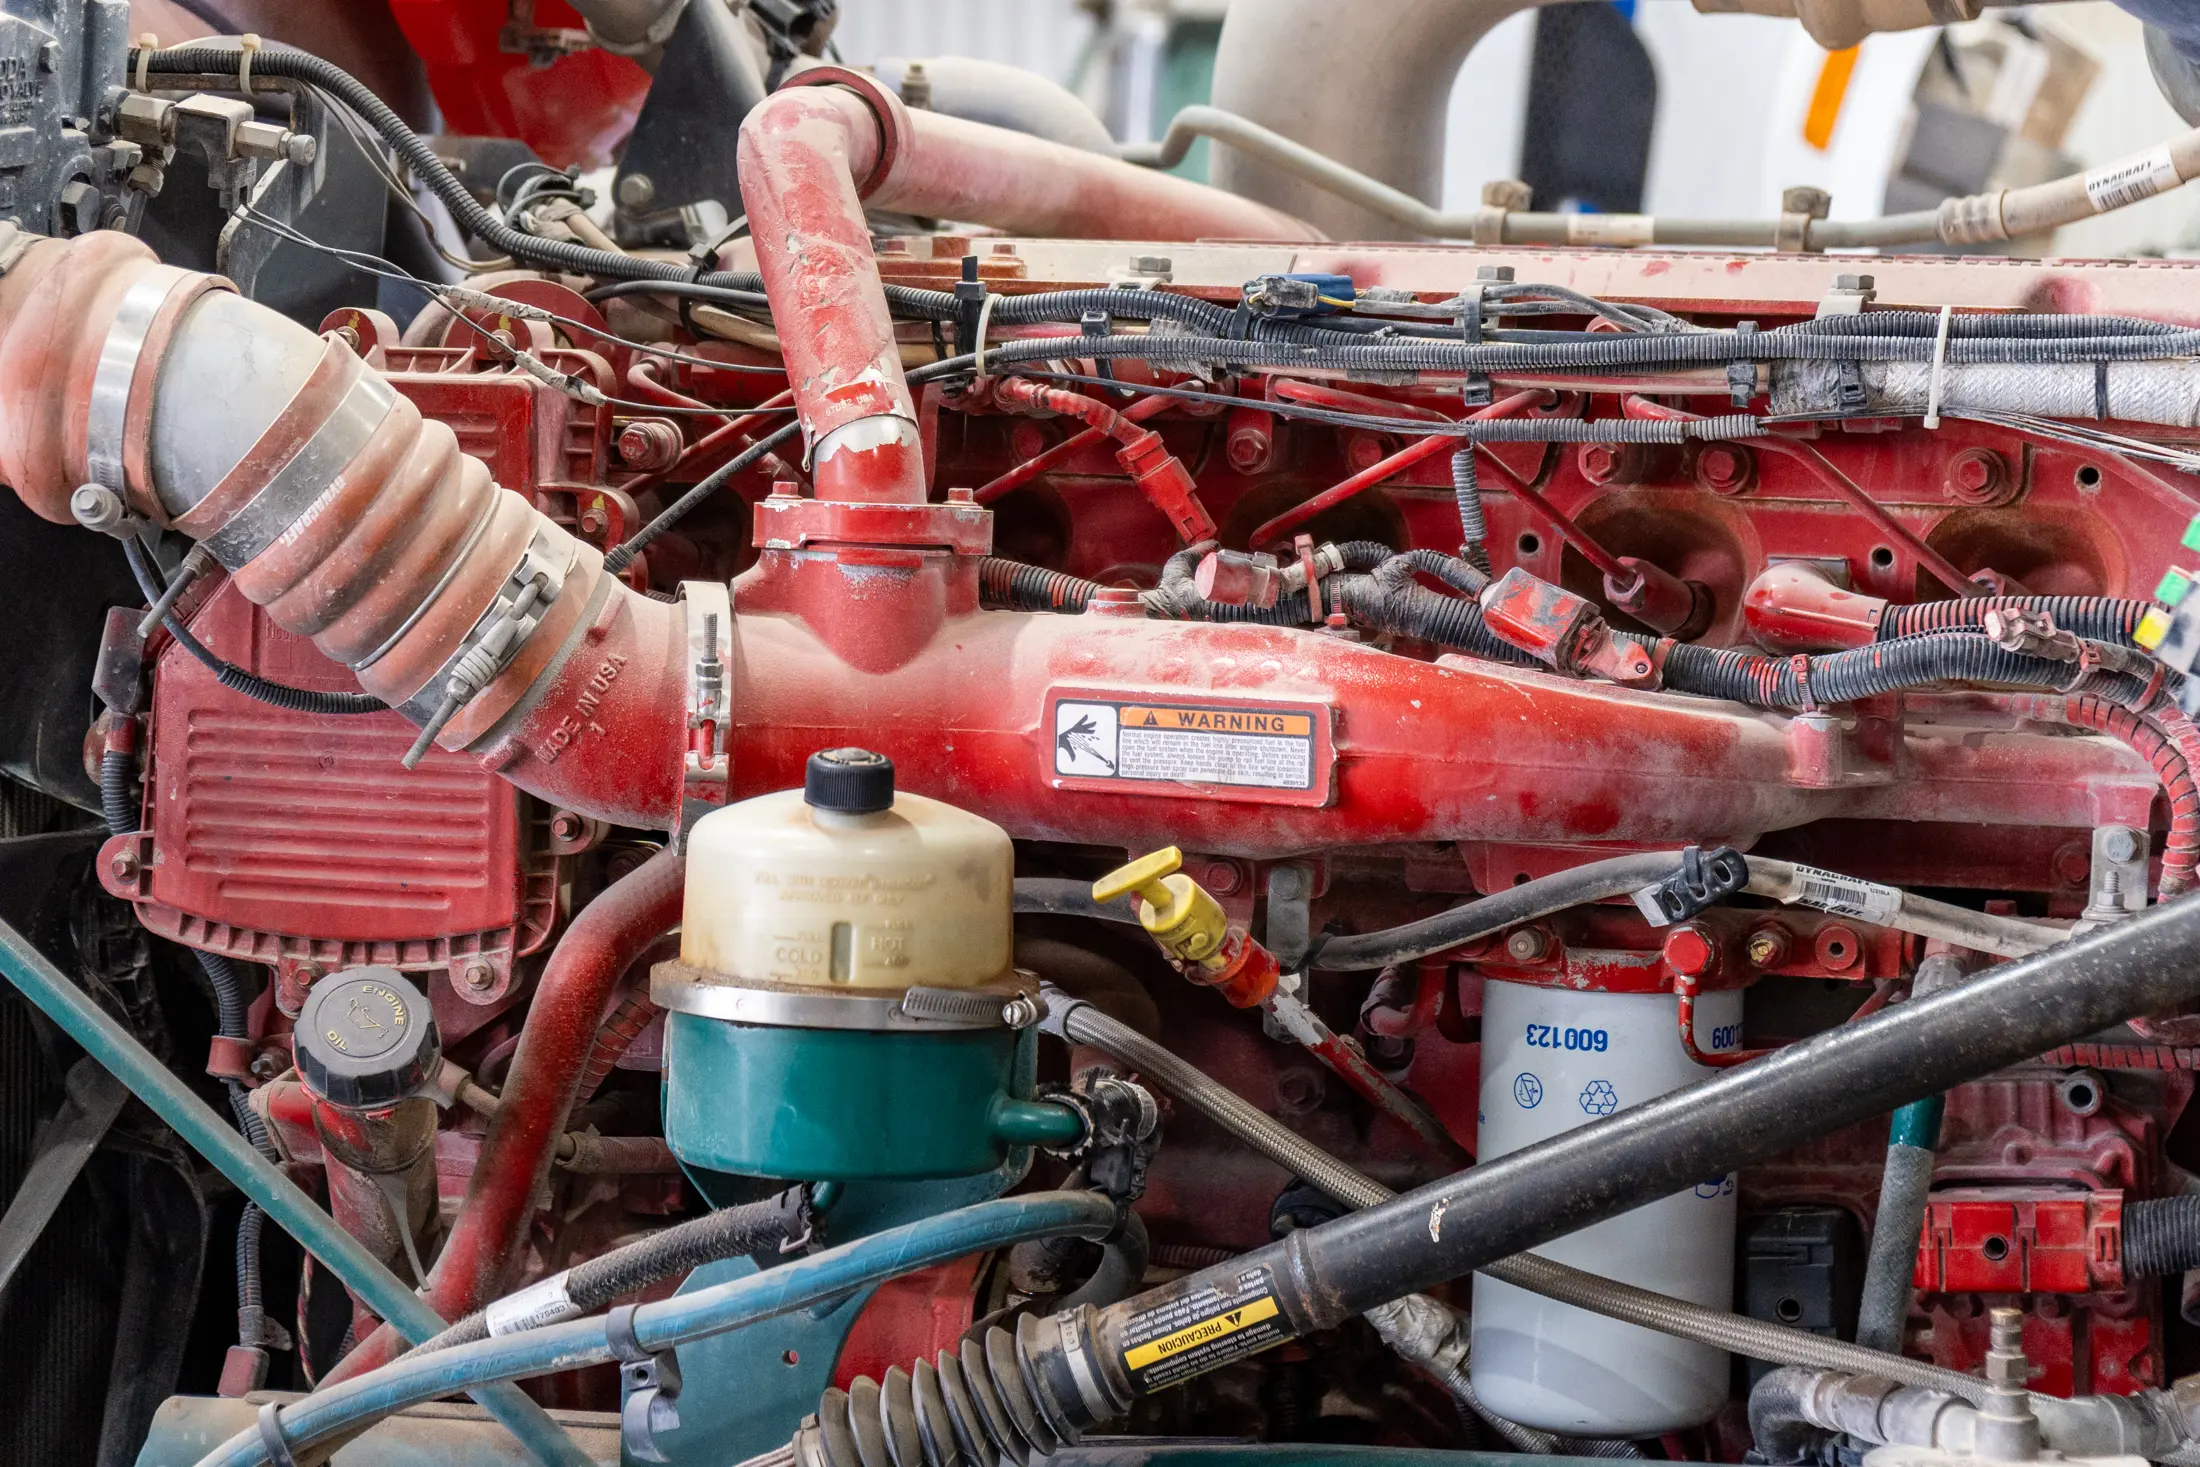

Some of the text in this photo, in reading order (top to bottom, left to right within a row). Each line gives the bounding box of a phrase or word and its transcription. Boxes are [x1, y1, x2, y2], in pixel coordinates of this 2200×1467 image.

[534, 652, 628, 764] MADE IN USA
[1178, 712, 1285, 732] WARNING
[775, 946, 824, 964] COLD
[869, 935, 905, 951] HOT
[362, 985, 406, 1026] ENGINE
[327, 1030, 348, 1052] OIL
[1526, 1023, 1608, 1052] 600123
[1158, 1321, 1223, 1355] PRECAUCION
